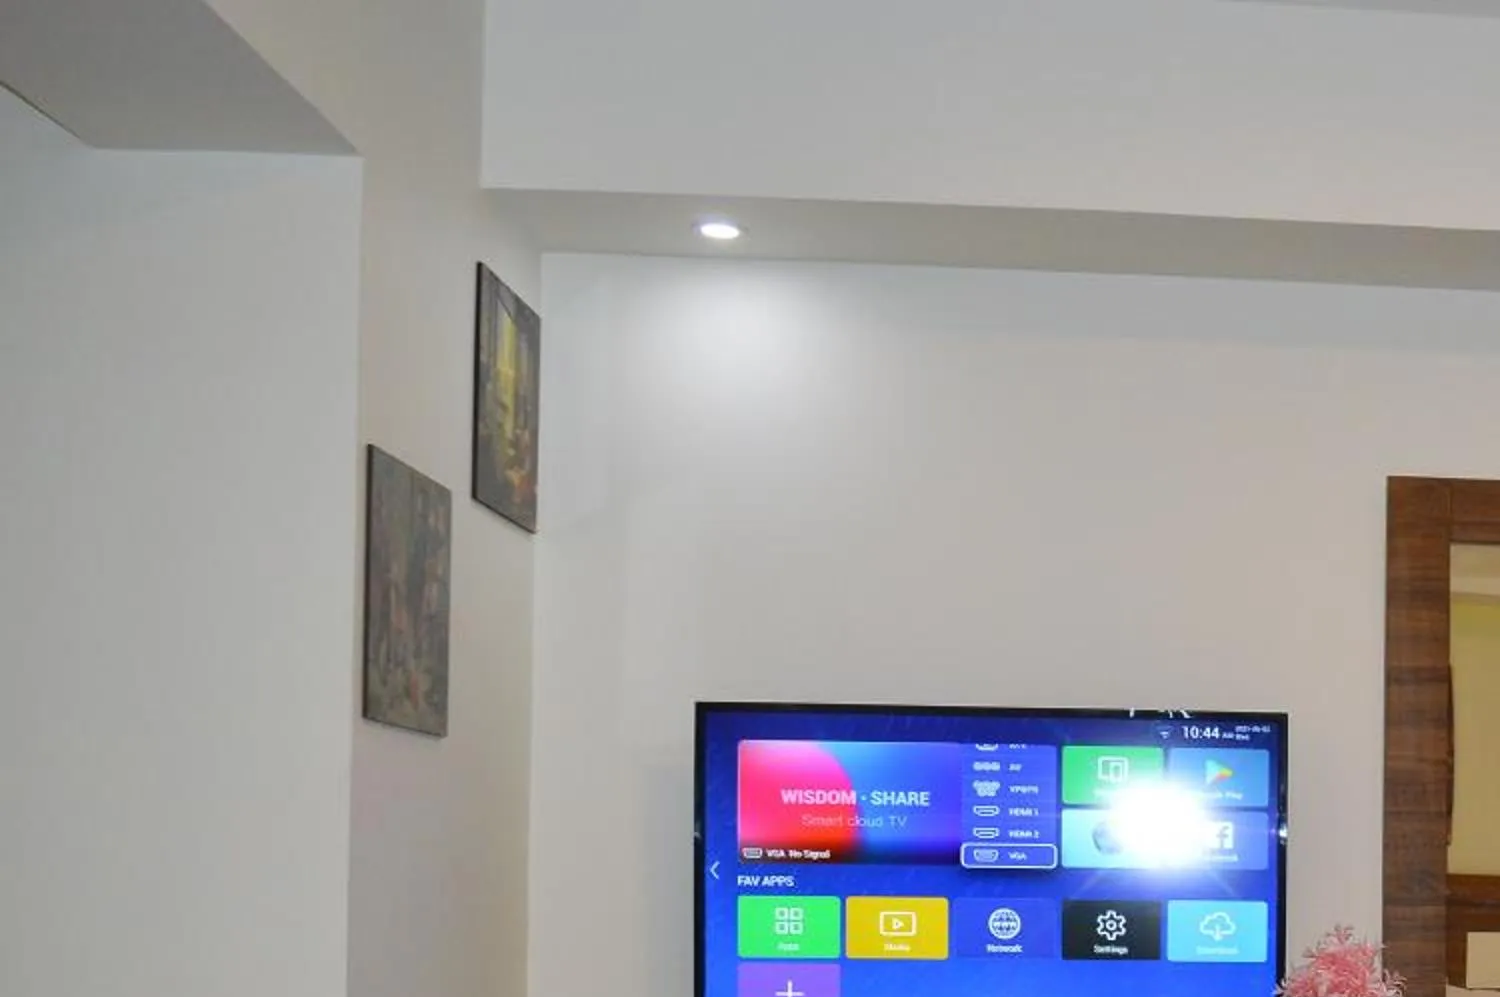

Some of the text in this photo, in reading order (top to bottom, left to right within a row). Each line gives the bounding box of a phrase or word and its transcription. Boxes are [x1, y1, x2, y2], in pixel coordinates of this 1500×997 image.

[1181, 725, 1220, 739] 10:44
[780, 788, 931, 807] WISDOM SHARE
[802, 813, 908, 829] Smart cloud TV
[736, 874, 796, 888] FAV APPS
[1093, 943, 1129, 956] Settings
